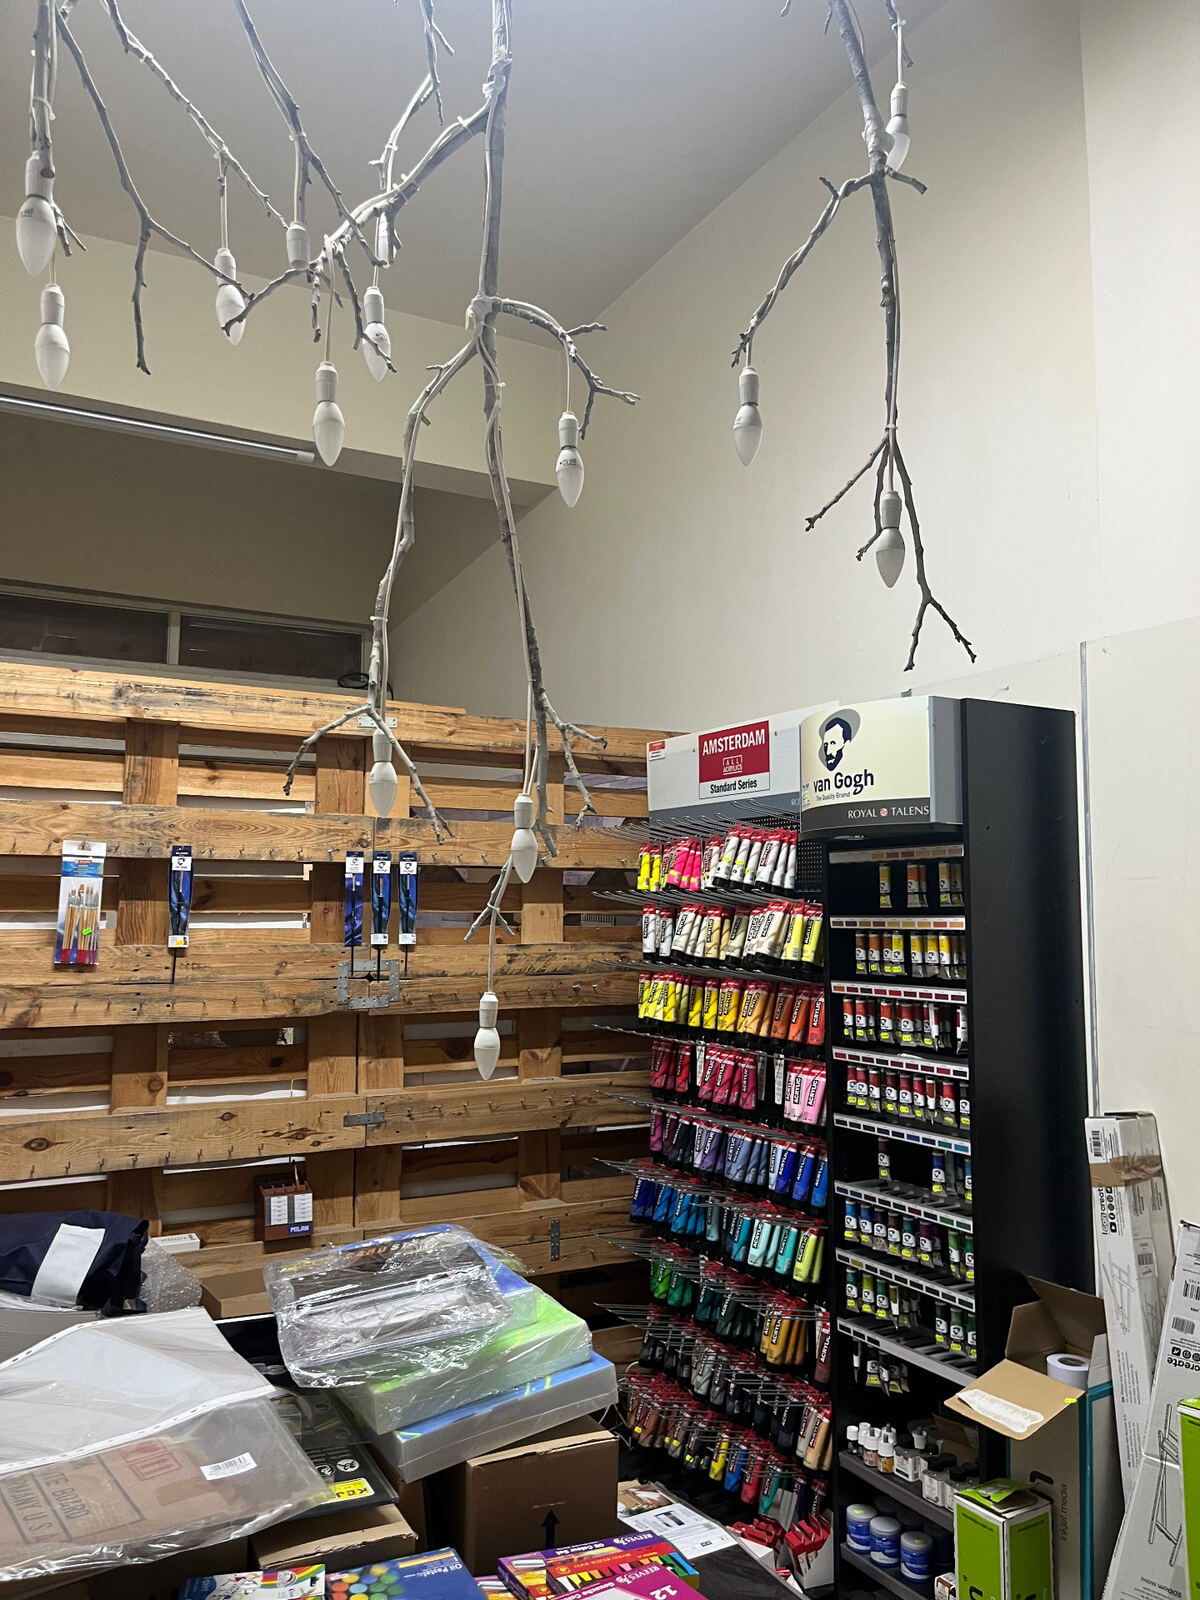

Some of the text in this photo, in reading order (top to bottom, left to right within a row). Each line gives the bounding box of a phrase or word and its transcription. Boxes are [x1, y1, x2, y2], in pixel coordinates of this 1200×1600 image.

[702, 728, 765, 756] AMSTERDAM
[723, 764, 743, 772] ACRYLICS
[710, 778, 758, 794] Standard Series
[813, 777, 831, 793] van
[834, 769, 874, 795] Gogh
[822, 793, 835, 801] Quality
[836, 791, 851, 799] Brand
[847, 805, 930, 819] ROYAL TALENS
[1098, 1187, 1106, 1212] creat
[290, 1225, 309, 1233] MILAN
[820, 1335, 831, 1363] ACRYLIC
[1167, 1357, 1200, 1372] create
[52, 1487, 90, 1520] BOARD
[625, 1531, 654, 1544] REEVES
[422, 1562, 463, 1577] Oil Pastel
[630, 1564, 660, 1582] REEVES
[582, 1581, 615, 1596] Gouache
[649, 1584, 678, 1600] 12
